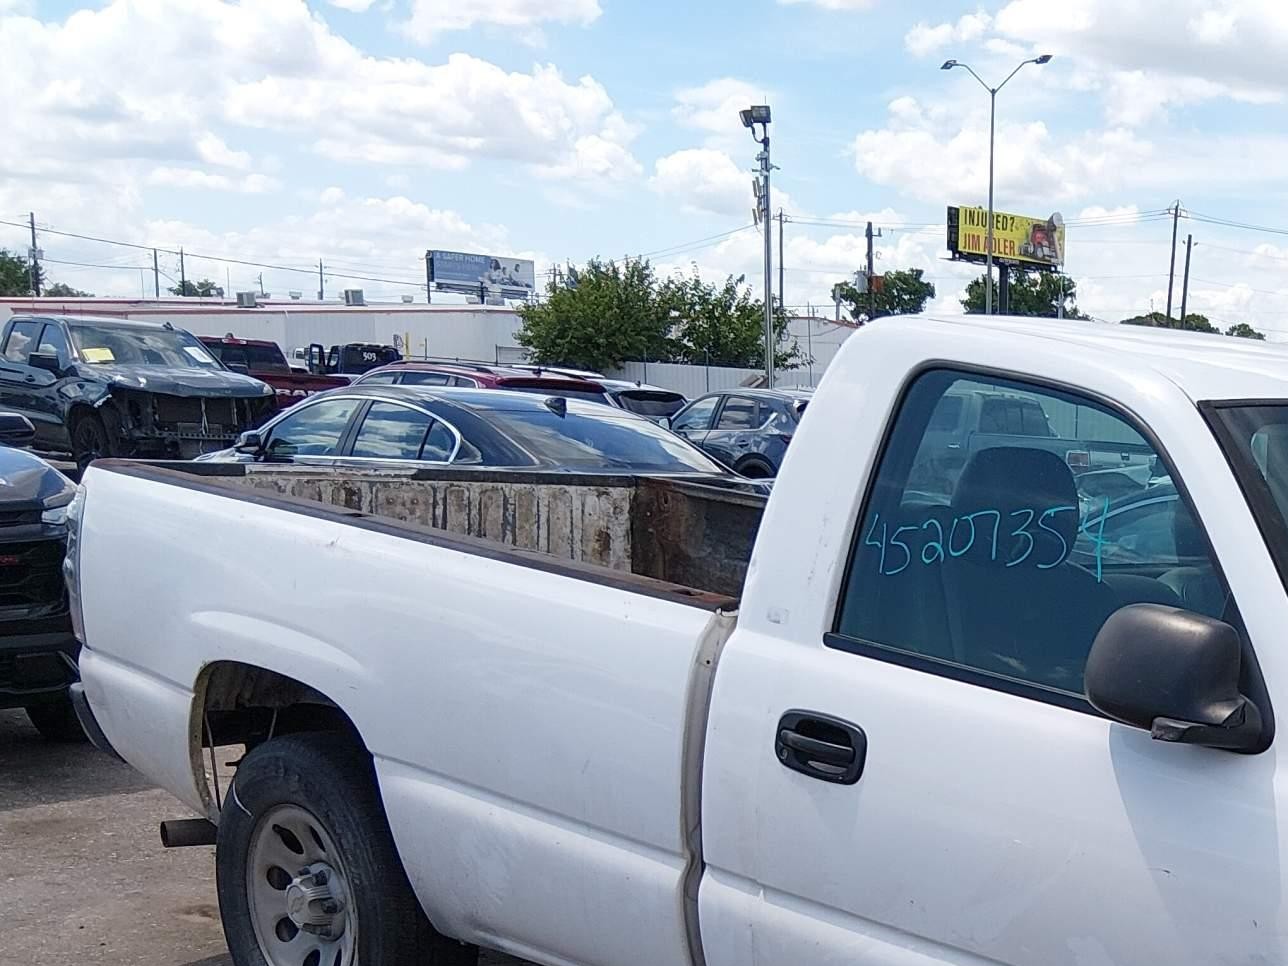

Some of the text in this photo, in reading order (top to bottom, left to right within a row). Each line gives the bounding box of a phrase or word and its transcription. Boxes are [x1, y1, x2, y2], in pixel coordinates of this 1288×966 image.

[963, 232, 981, 252] JIM
[362, 351, 377, 362] 503
[864, 496, 1111, 583] 45207354
